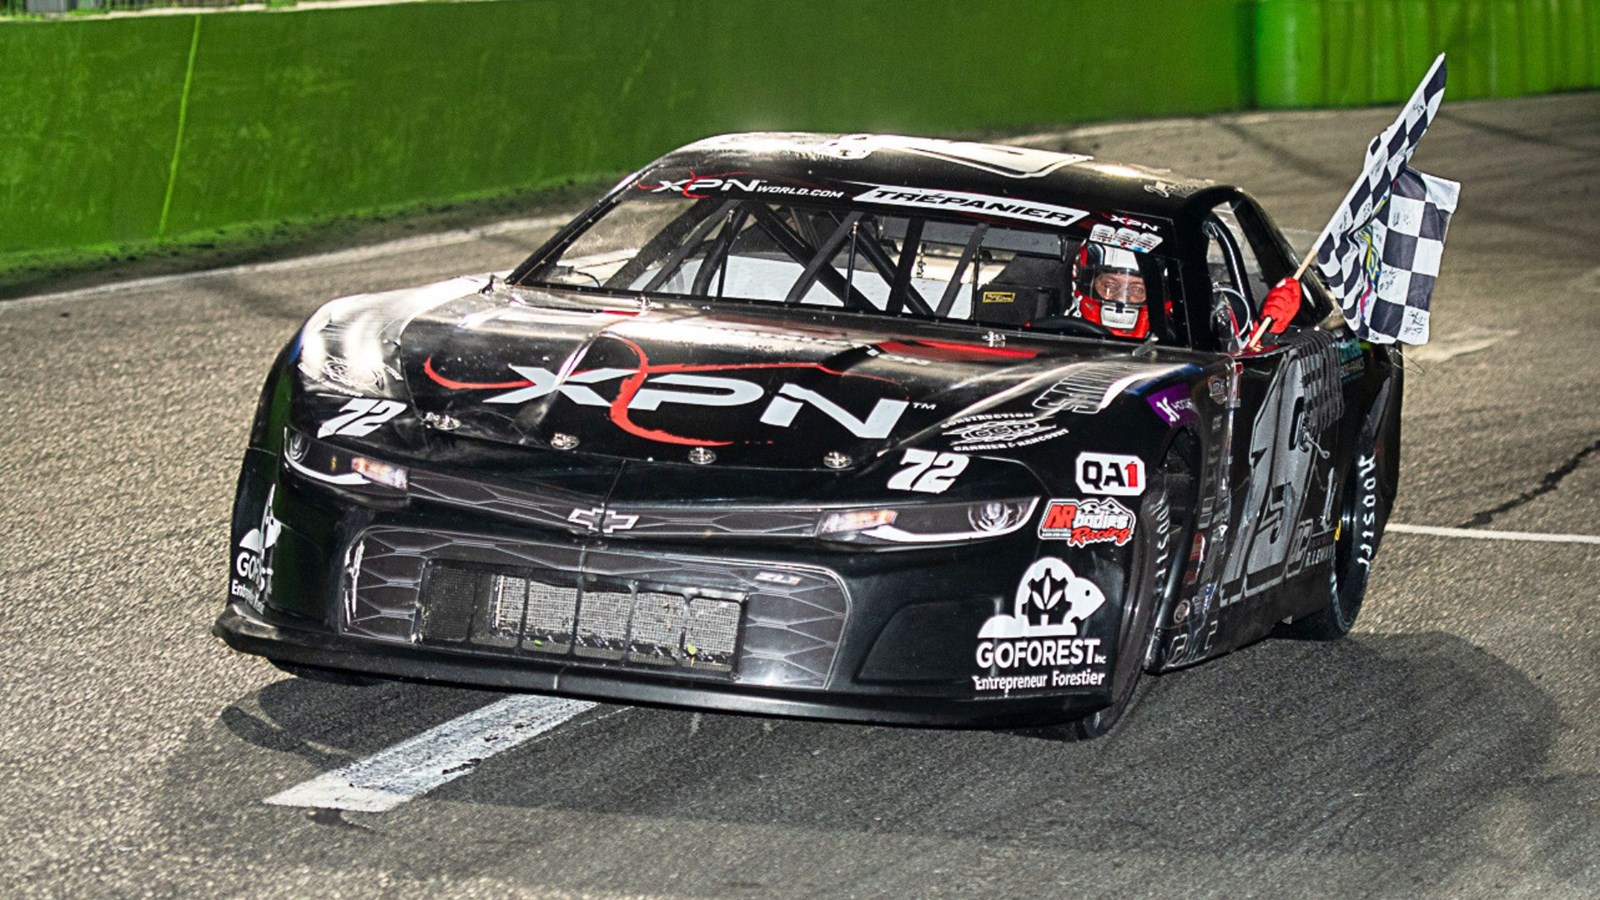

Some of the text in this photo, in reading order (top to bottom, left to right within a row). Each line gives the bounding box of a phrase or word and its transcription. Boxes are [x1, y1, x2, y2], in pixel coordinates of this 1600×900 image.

[874, 190, 1076, 222] TRÉPANIER
[317, 398, 408, 438] 72
[887, 448, 970, 494] 72
[1082, 460, 1139, 491] QA1
[1070, 525, 1132, 545] Racing
[975, 638, 1102, 669] GOFOREST
[971, 668, 1106, 695] Entrepreneur Forestier
